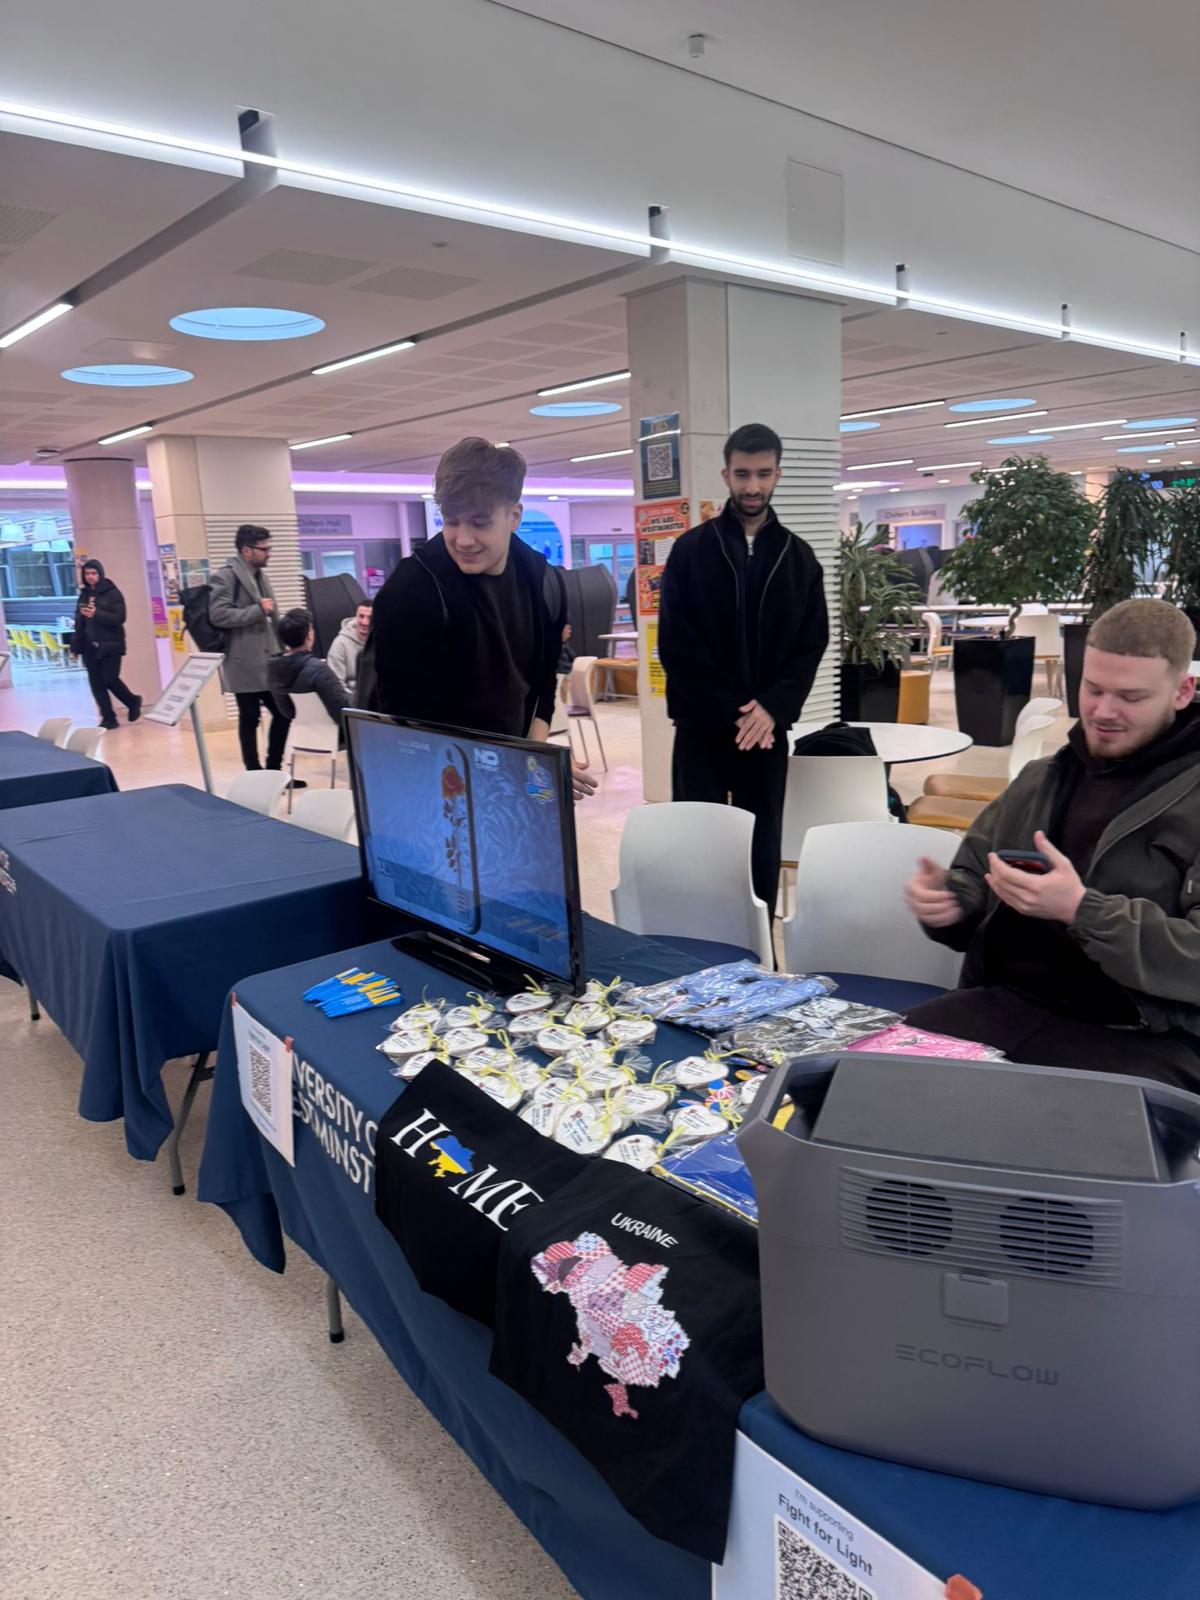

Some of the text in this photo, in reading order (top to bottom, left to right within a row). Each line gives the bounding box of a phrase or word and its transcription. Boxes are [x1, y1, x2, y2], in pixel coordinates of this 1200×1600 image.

[473, 747, 498, 765] NO
[293, 1053, 364, 1142] VERSITY
[611, 1212, 679, 1248] UKRAINE
[896, 1344, 1059, 1385] ECOFLOW
[779, 1493, 873, 1577] Fight for Light
[809, 1501, 854, 1542] supporting
